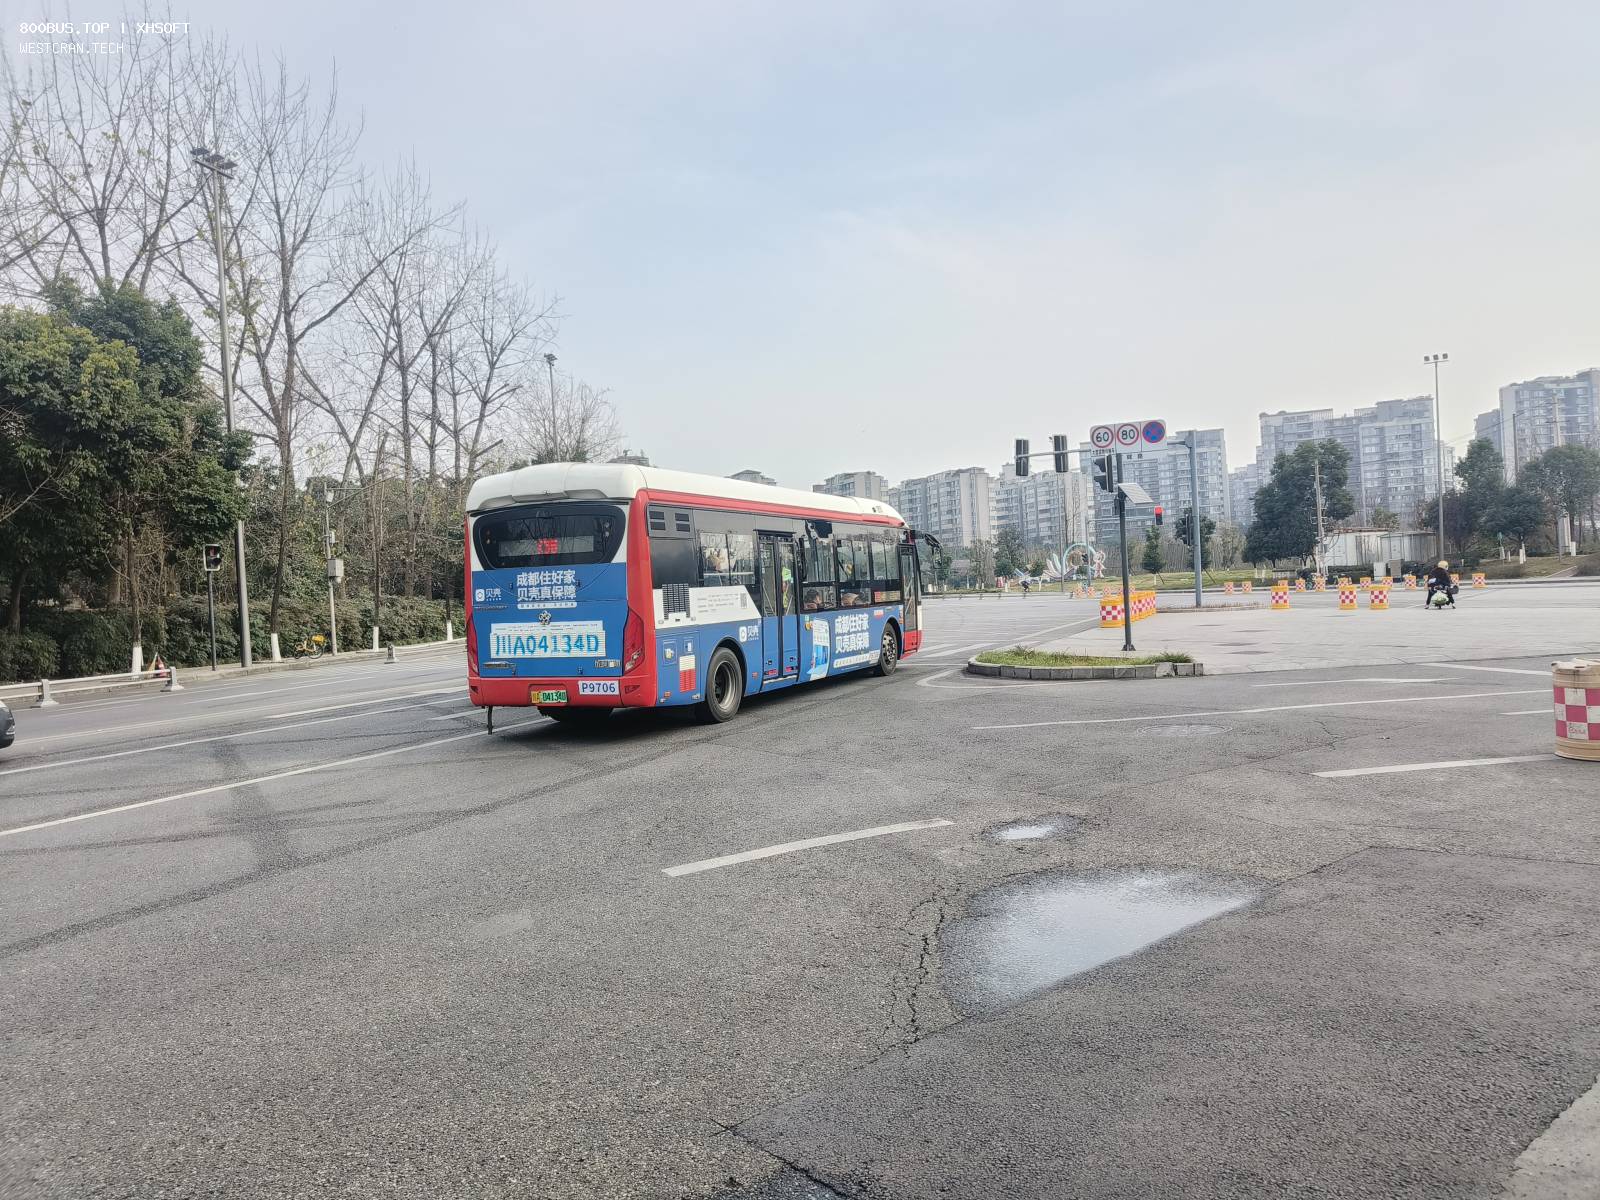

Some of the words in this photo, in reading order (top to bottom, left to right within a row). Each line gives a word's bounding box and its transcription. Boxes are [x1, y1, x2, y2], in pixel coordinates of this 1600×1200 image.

[1095, 431, 1110, 443] 60
[1121, 429, 1136, 440] 80
[516, 569, 576, 587] 成都住好家
[516, 586, 577, 602] 贝壳真保障
[495, 634, 600, 656] 川A04134D
[581, 682, 616, 693] P9706
